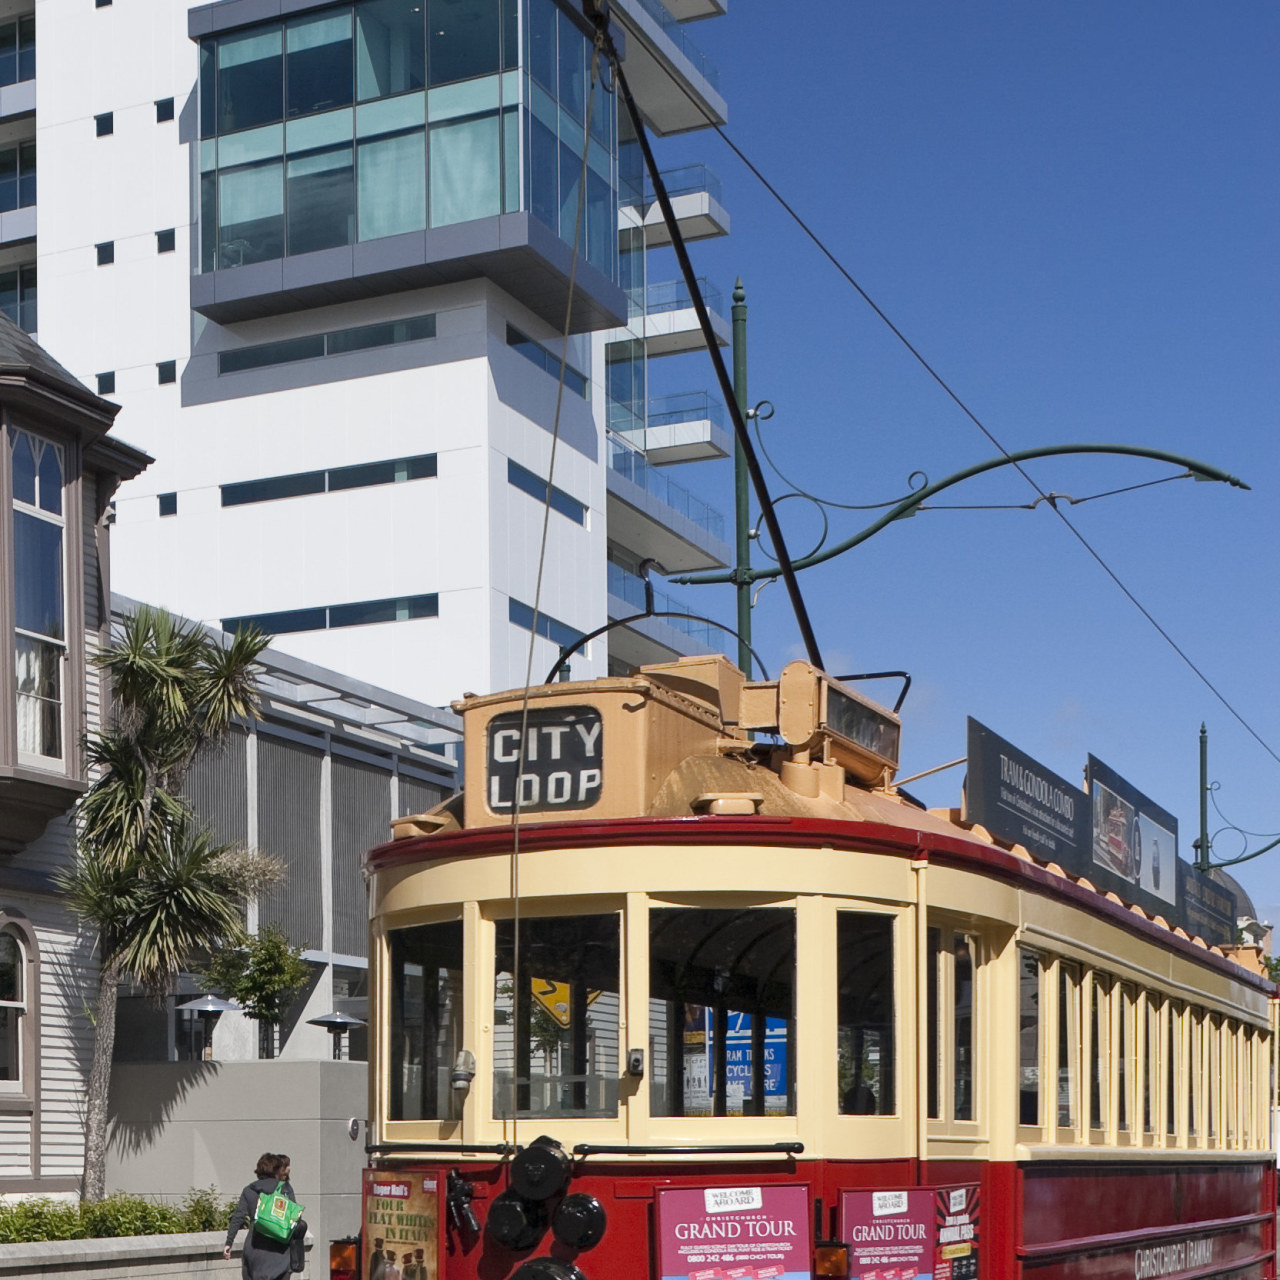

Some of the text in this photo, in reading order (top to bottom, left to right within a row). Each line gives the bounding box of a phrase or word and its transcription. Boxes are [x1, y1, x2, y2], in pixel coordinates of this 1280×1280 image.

[493, 722, 601, 763] CITY
[490, 769, 601, 808] LOOP
[726, 1049, 743, 1061] RAM
[711, 1189, 754, 1199] WELCOME
[713, 1196, 755, 1207] ABOARD
[375, 1199, 404, 1212] FOUR
[368, 1211, 436, 1228] FLAT WHITES
[384, 1227, 396, 1240] IN
[674, 1220, 798, 1240] GRAND TOUR
[852, 1223, 927, 1241] GRAND TOUR
[706, 1254, 720, 1262] 242
[1134, 1237, 1214, 1280] CHRISTCHURCH TRAMWAY
